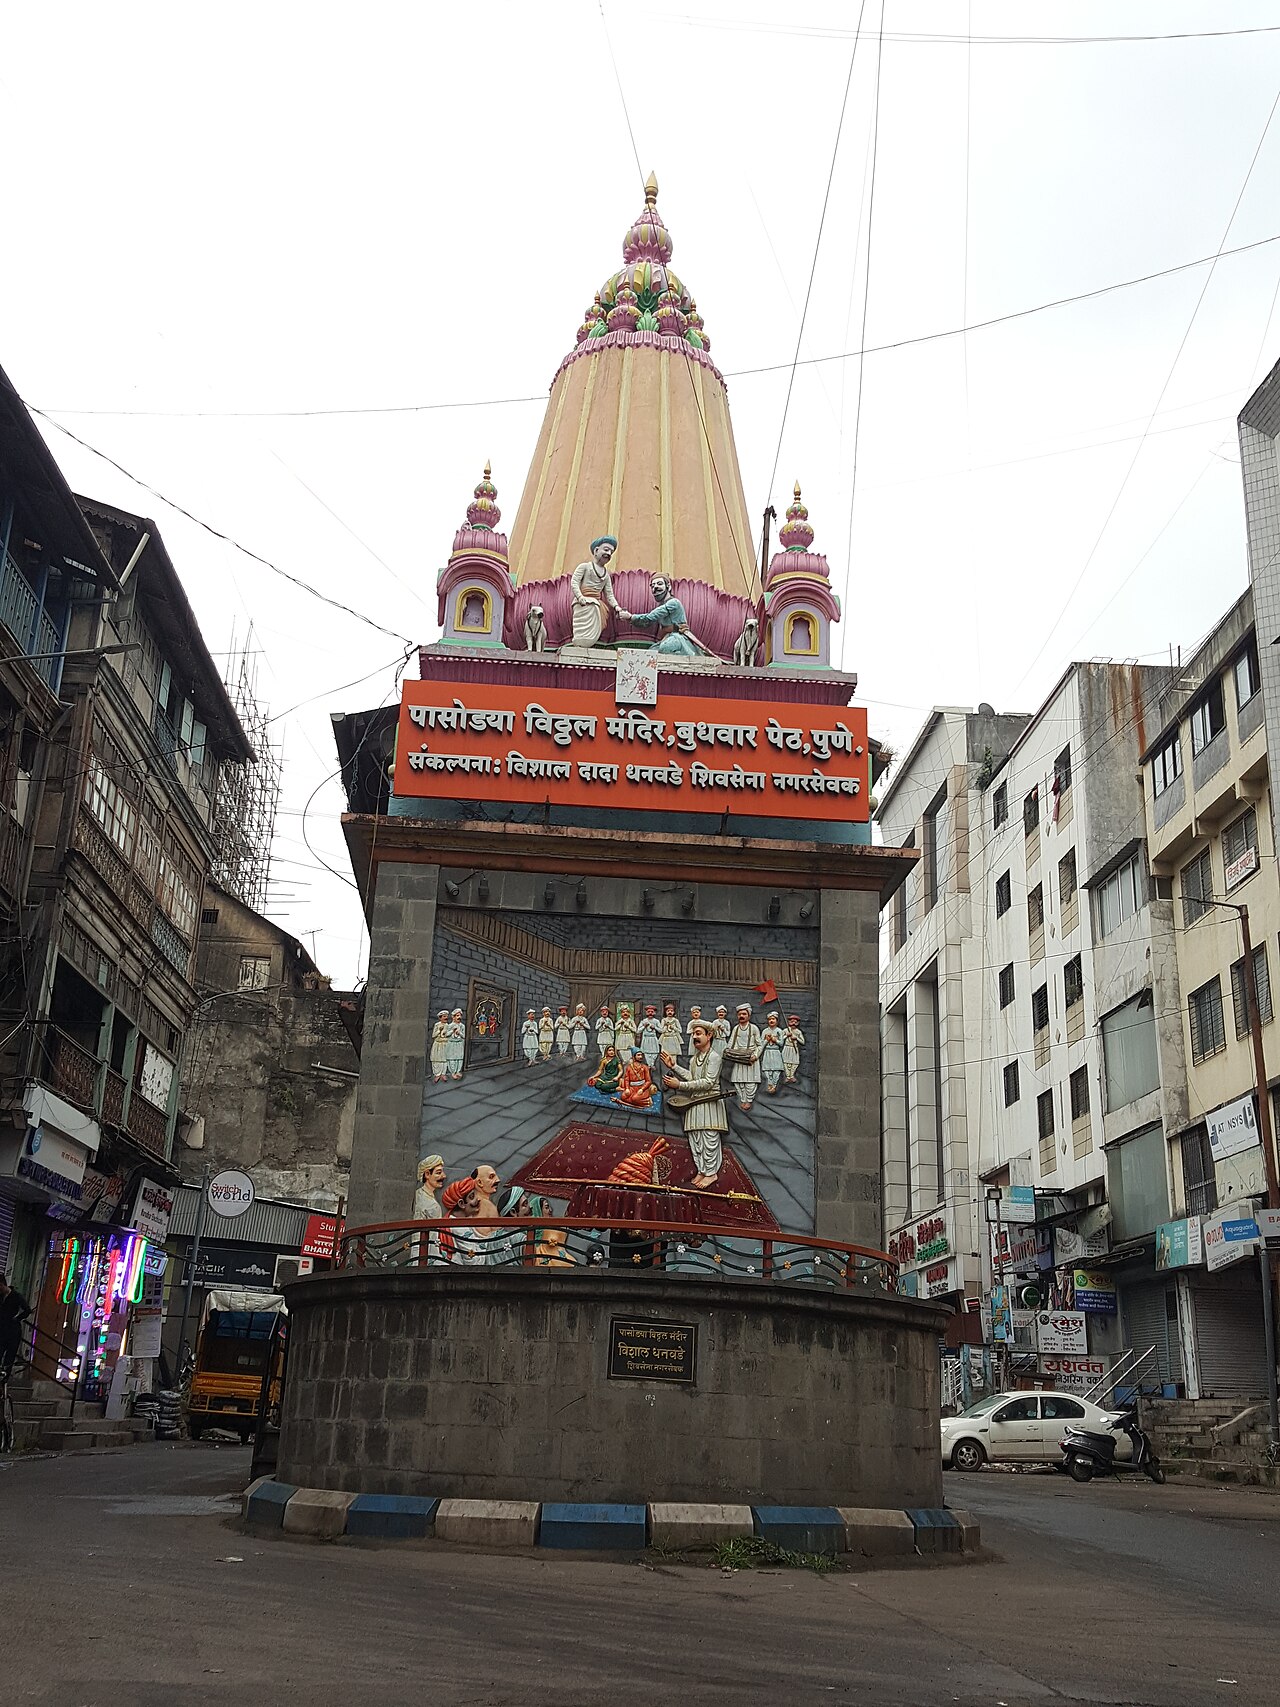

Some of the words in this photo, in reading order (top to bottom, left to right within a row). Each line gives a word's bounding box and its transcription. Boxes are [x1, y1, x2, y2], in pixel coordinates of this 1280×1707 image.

[523, 703, 598, 746] विठ्ठल
[408, 743, 501, 774] संकल्पना:
[505, 750, 572, 779] विशाल
[577, 762, 620, 783] दादा
[626, 760, 684, 785] धनवडे
[690, 761, 767, 790] शिवसेना
[772, 768, 860, 794] नगरसेवक
[211, 1182, 242, 1195] Switch
[211, 1189, 251, 1202] world
[1225, 1224, 1254, 1234] Aquaguard
[617, 1341, 650, 1359] विशाल
[652, 1345, 686, 1360] धनवडे
[1043, 1358, 1105, 1374] यशवंत
